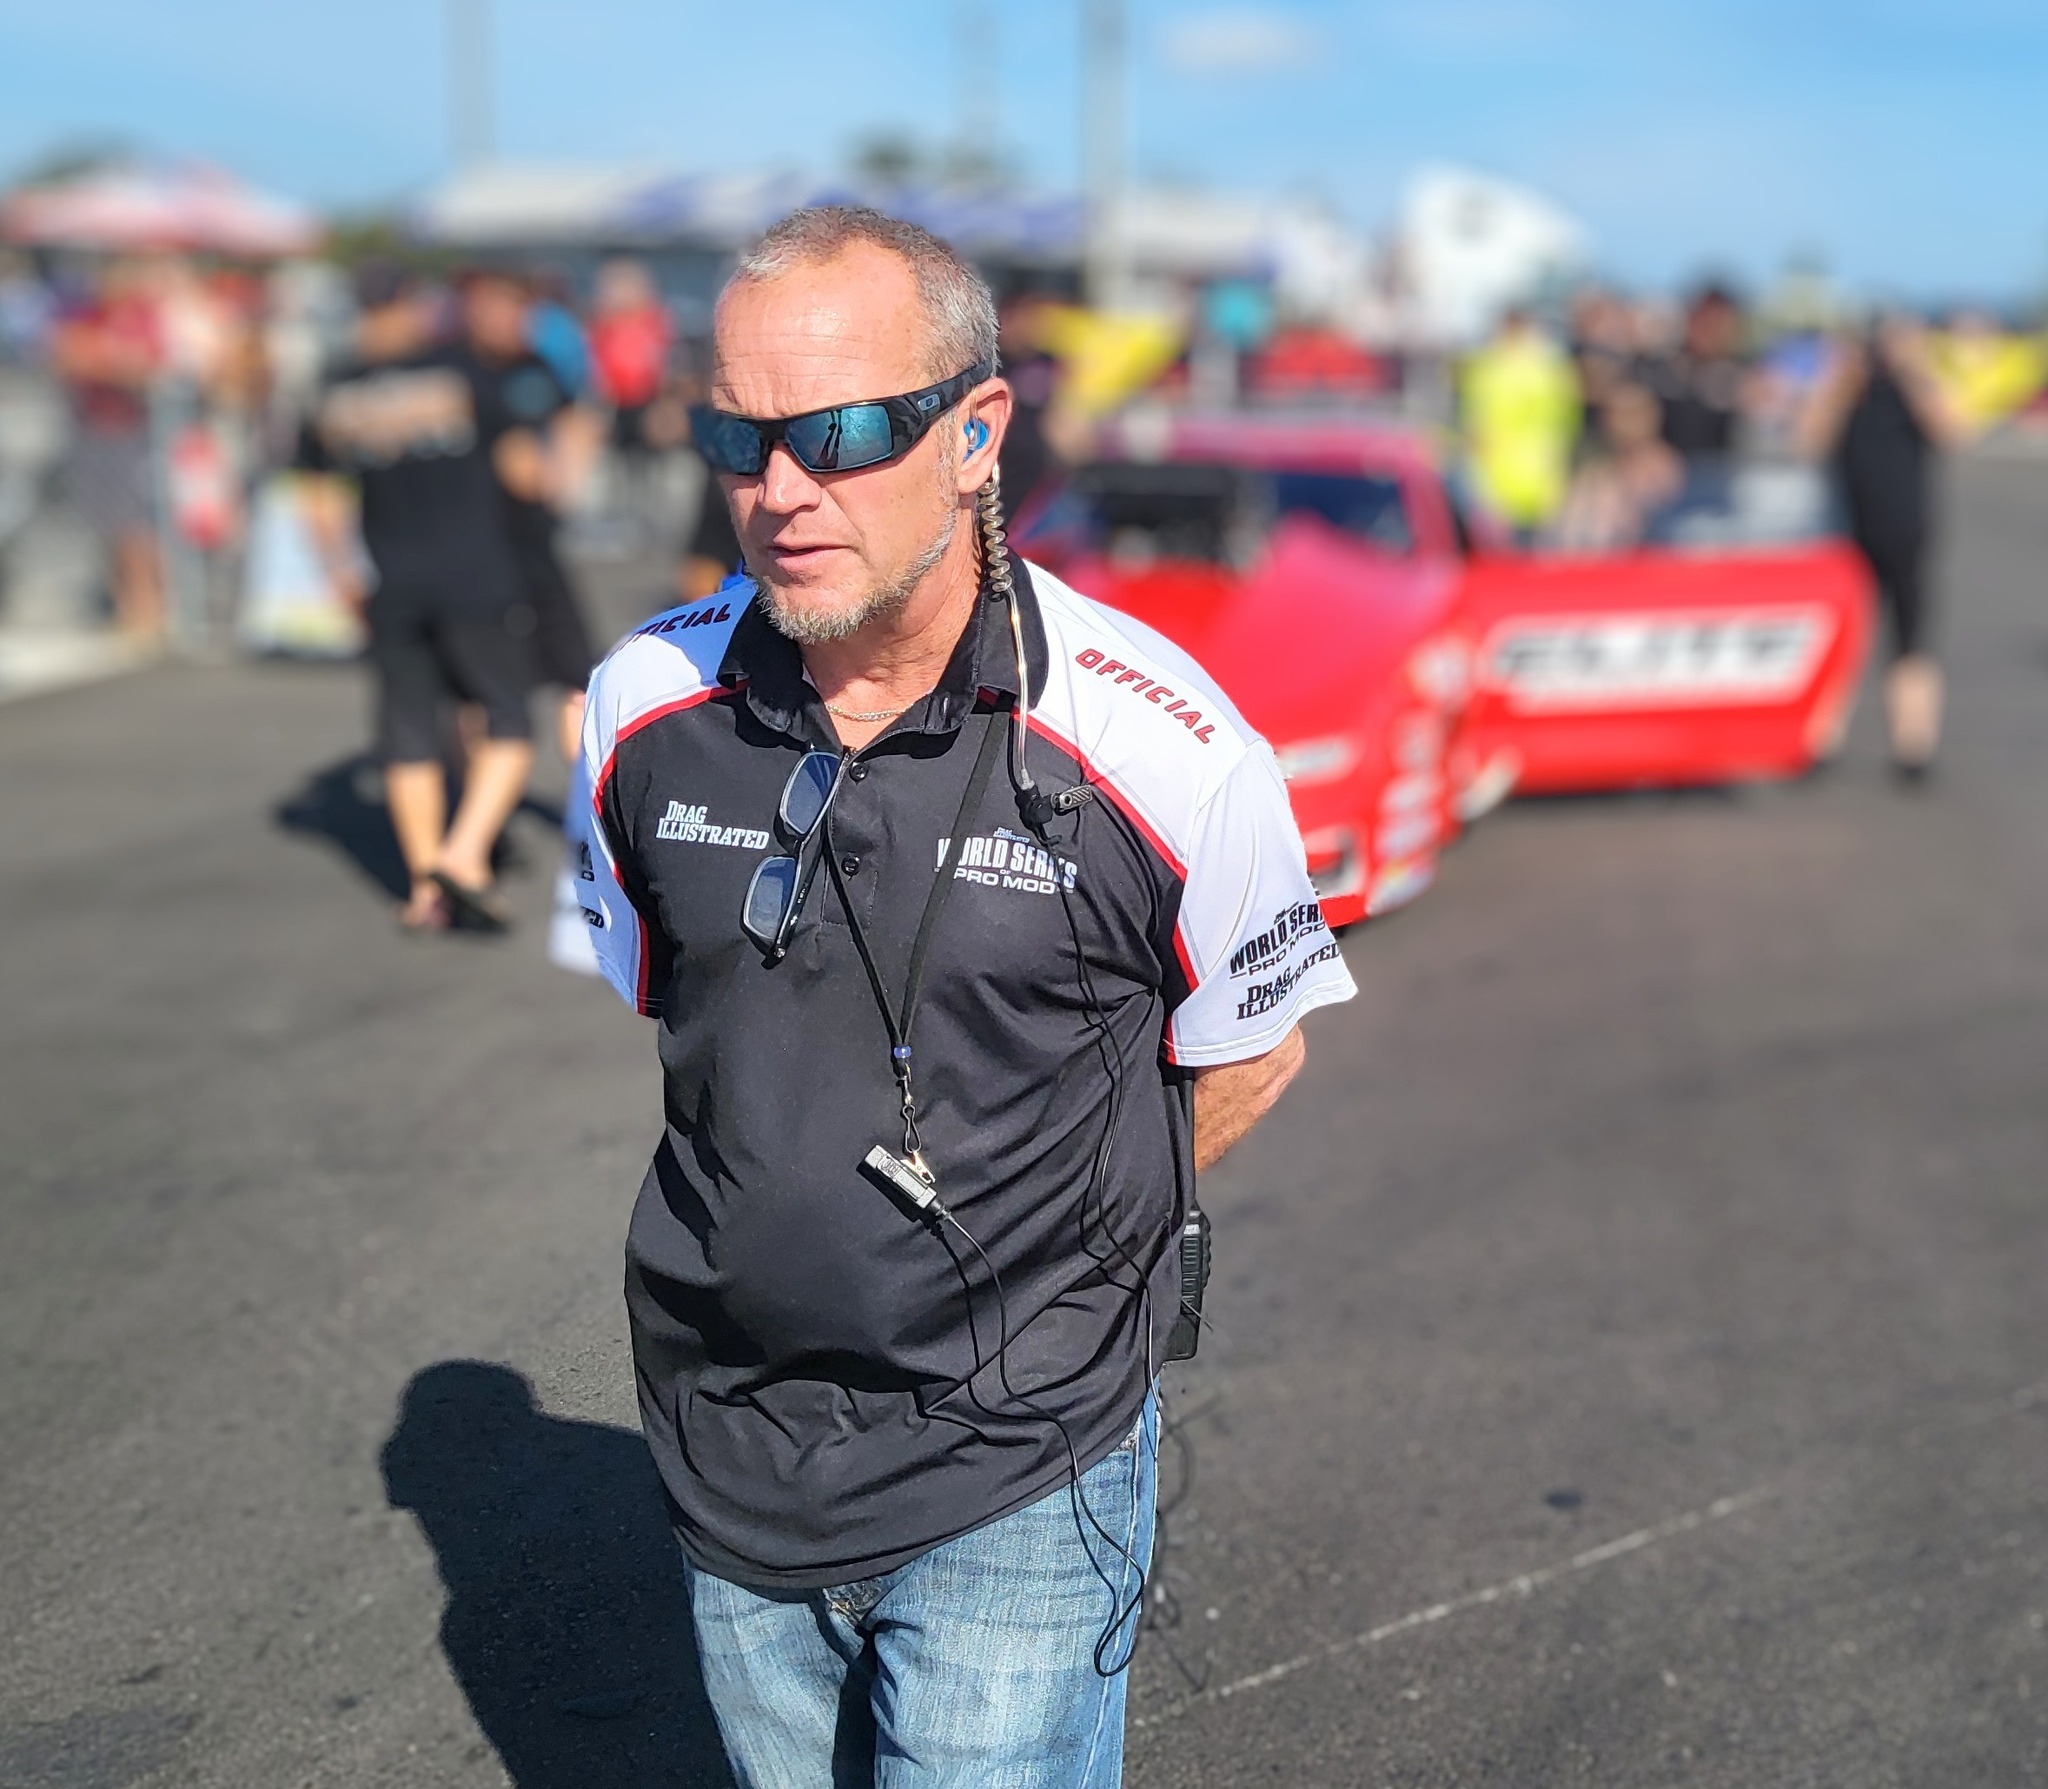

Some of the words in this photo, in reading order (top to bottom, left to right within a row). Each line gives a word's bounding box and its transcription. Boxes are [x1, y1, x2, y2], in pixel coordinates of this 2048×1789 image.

[616, 603, 731, 652] FICIAL
[1075, 648, 1215, 744] OFFICIAL
[655, 817, 770, 850] ILLUSTRATED
[665, 800, 708, 824] DRAG
[953, 867, 999, 886] PRO
[1002, 876, 1056, 894] MOD
[1229, 919, 1288, 975] WORLD
[1248, 948, 1287, 976] PRO
[1289, 921, 1326, 951] MOD
[1246, 966, 1291, 1004] DRAG
